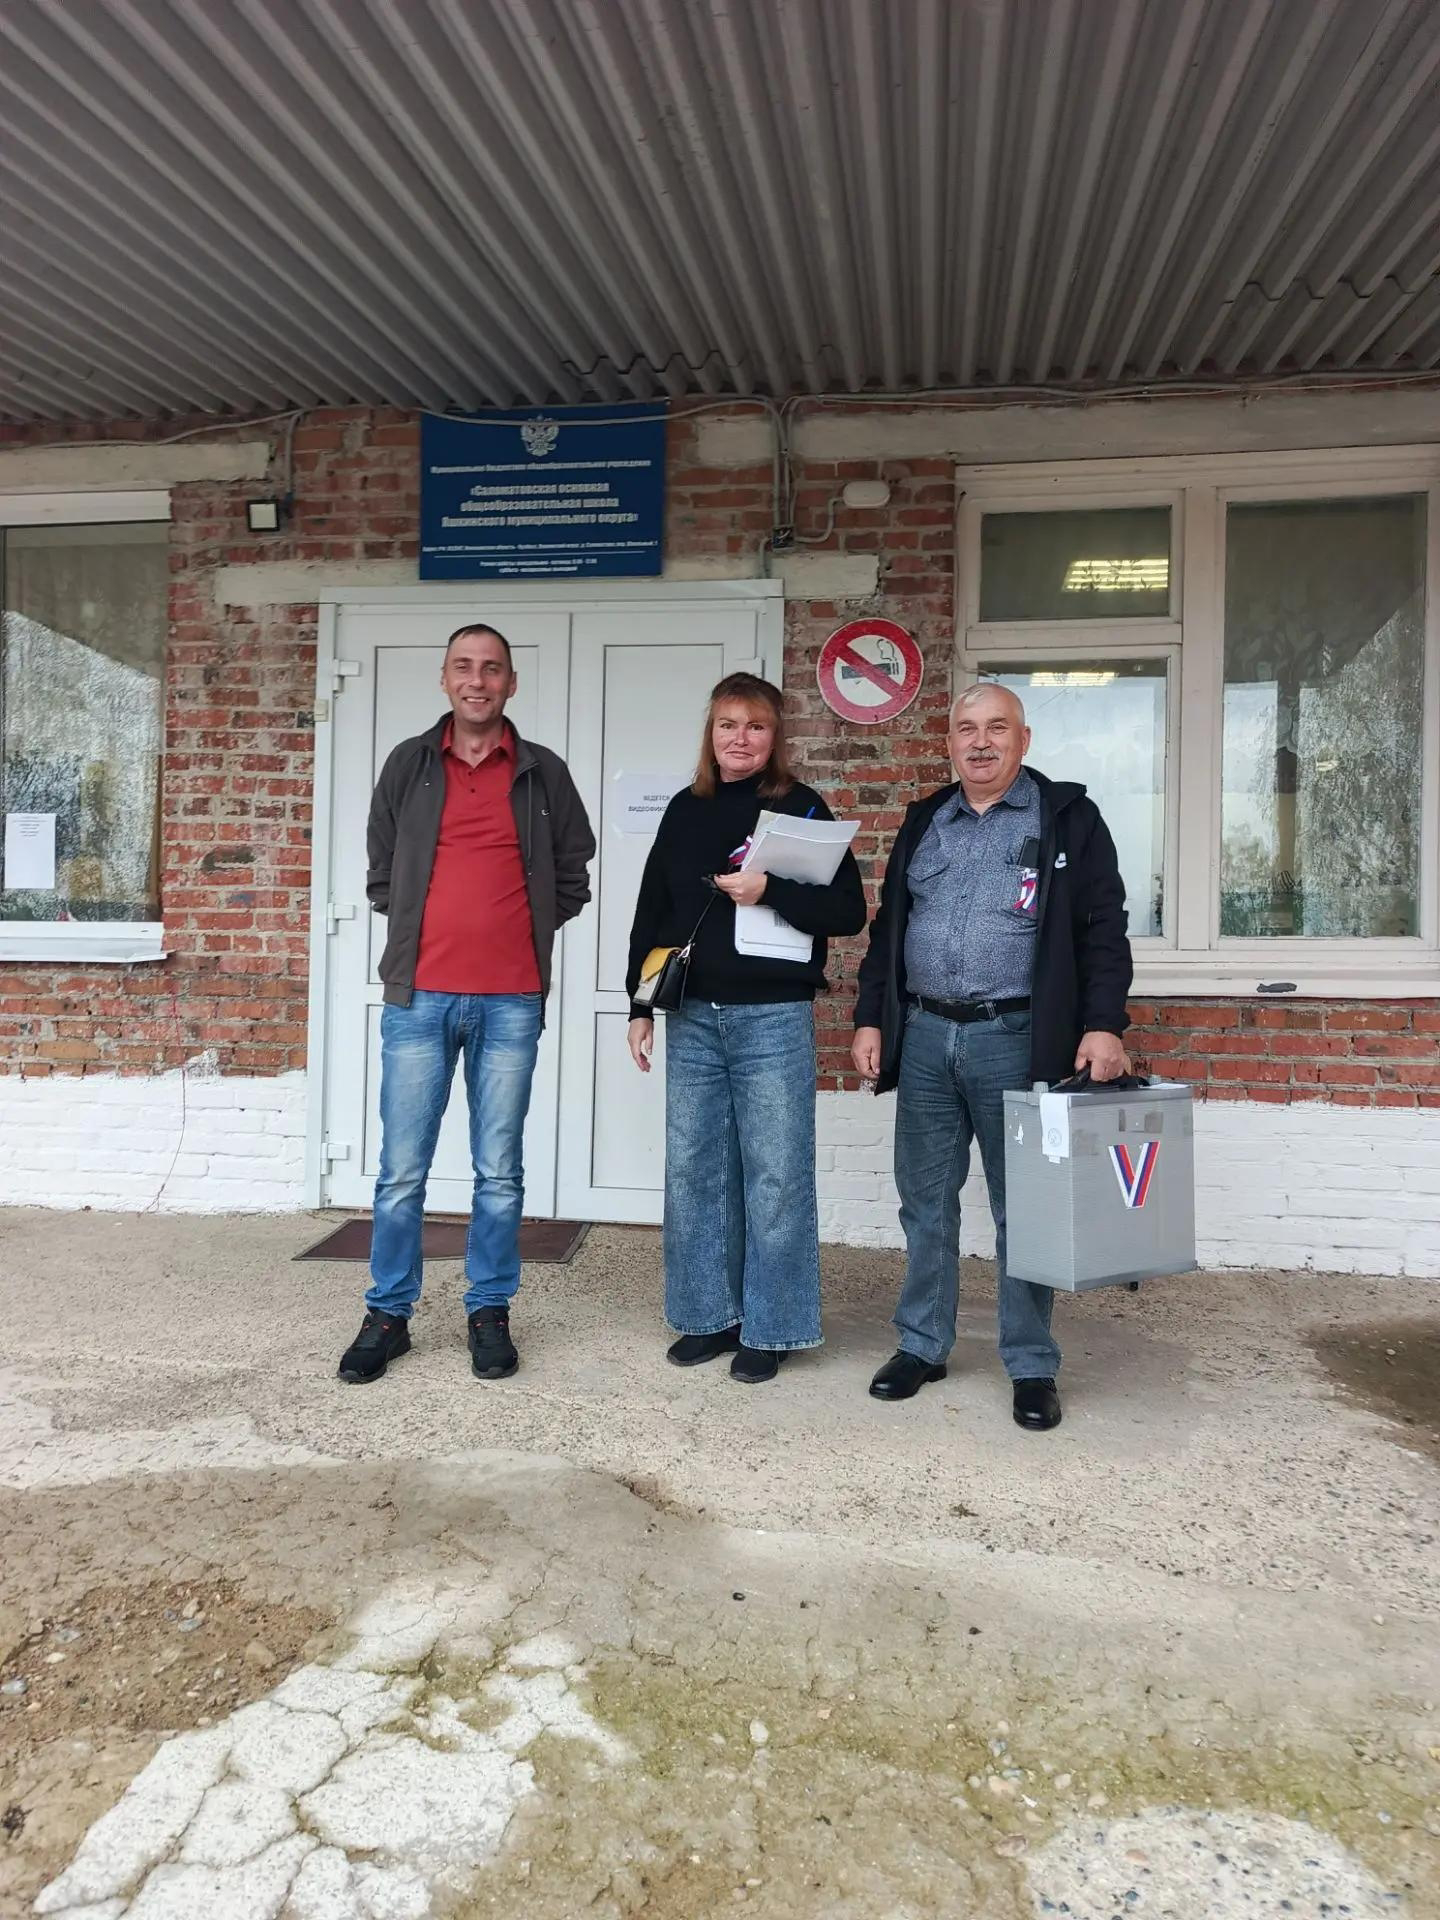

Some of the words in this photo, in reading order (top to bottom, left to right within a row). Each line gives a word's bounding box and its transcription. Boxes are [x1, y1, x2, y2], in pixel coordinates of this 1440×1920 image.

[558, 483, 610, 494] основная
[460, 499, 582, 512] общеобразовательная
[582, 498, 619, 508] школа
[507, 514, 597, 527] муниципального
